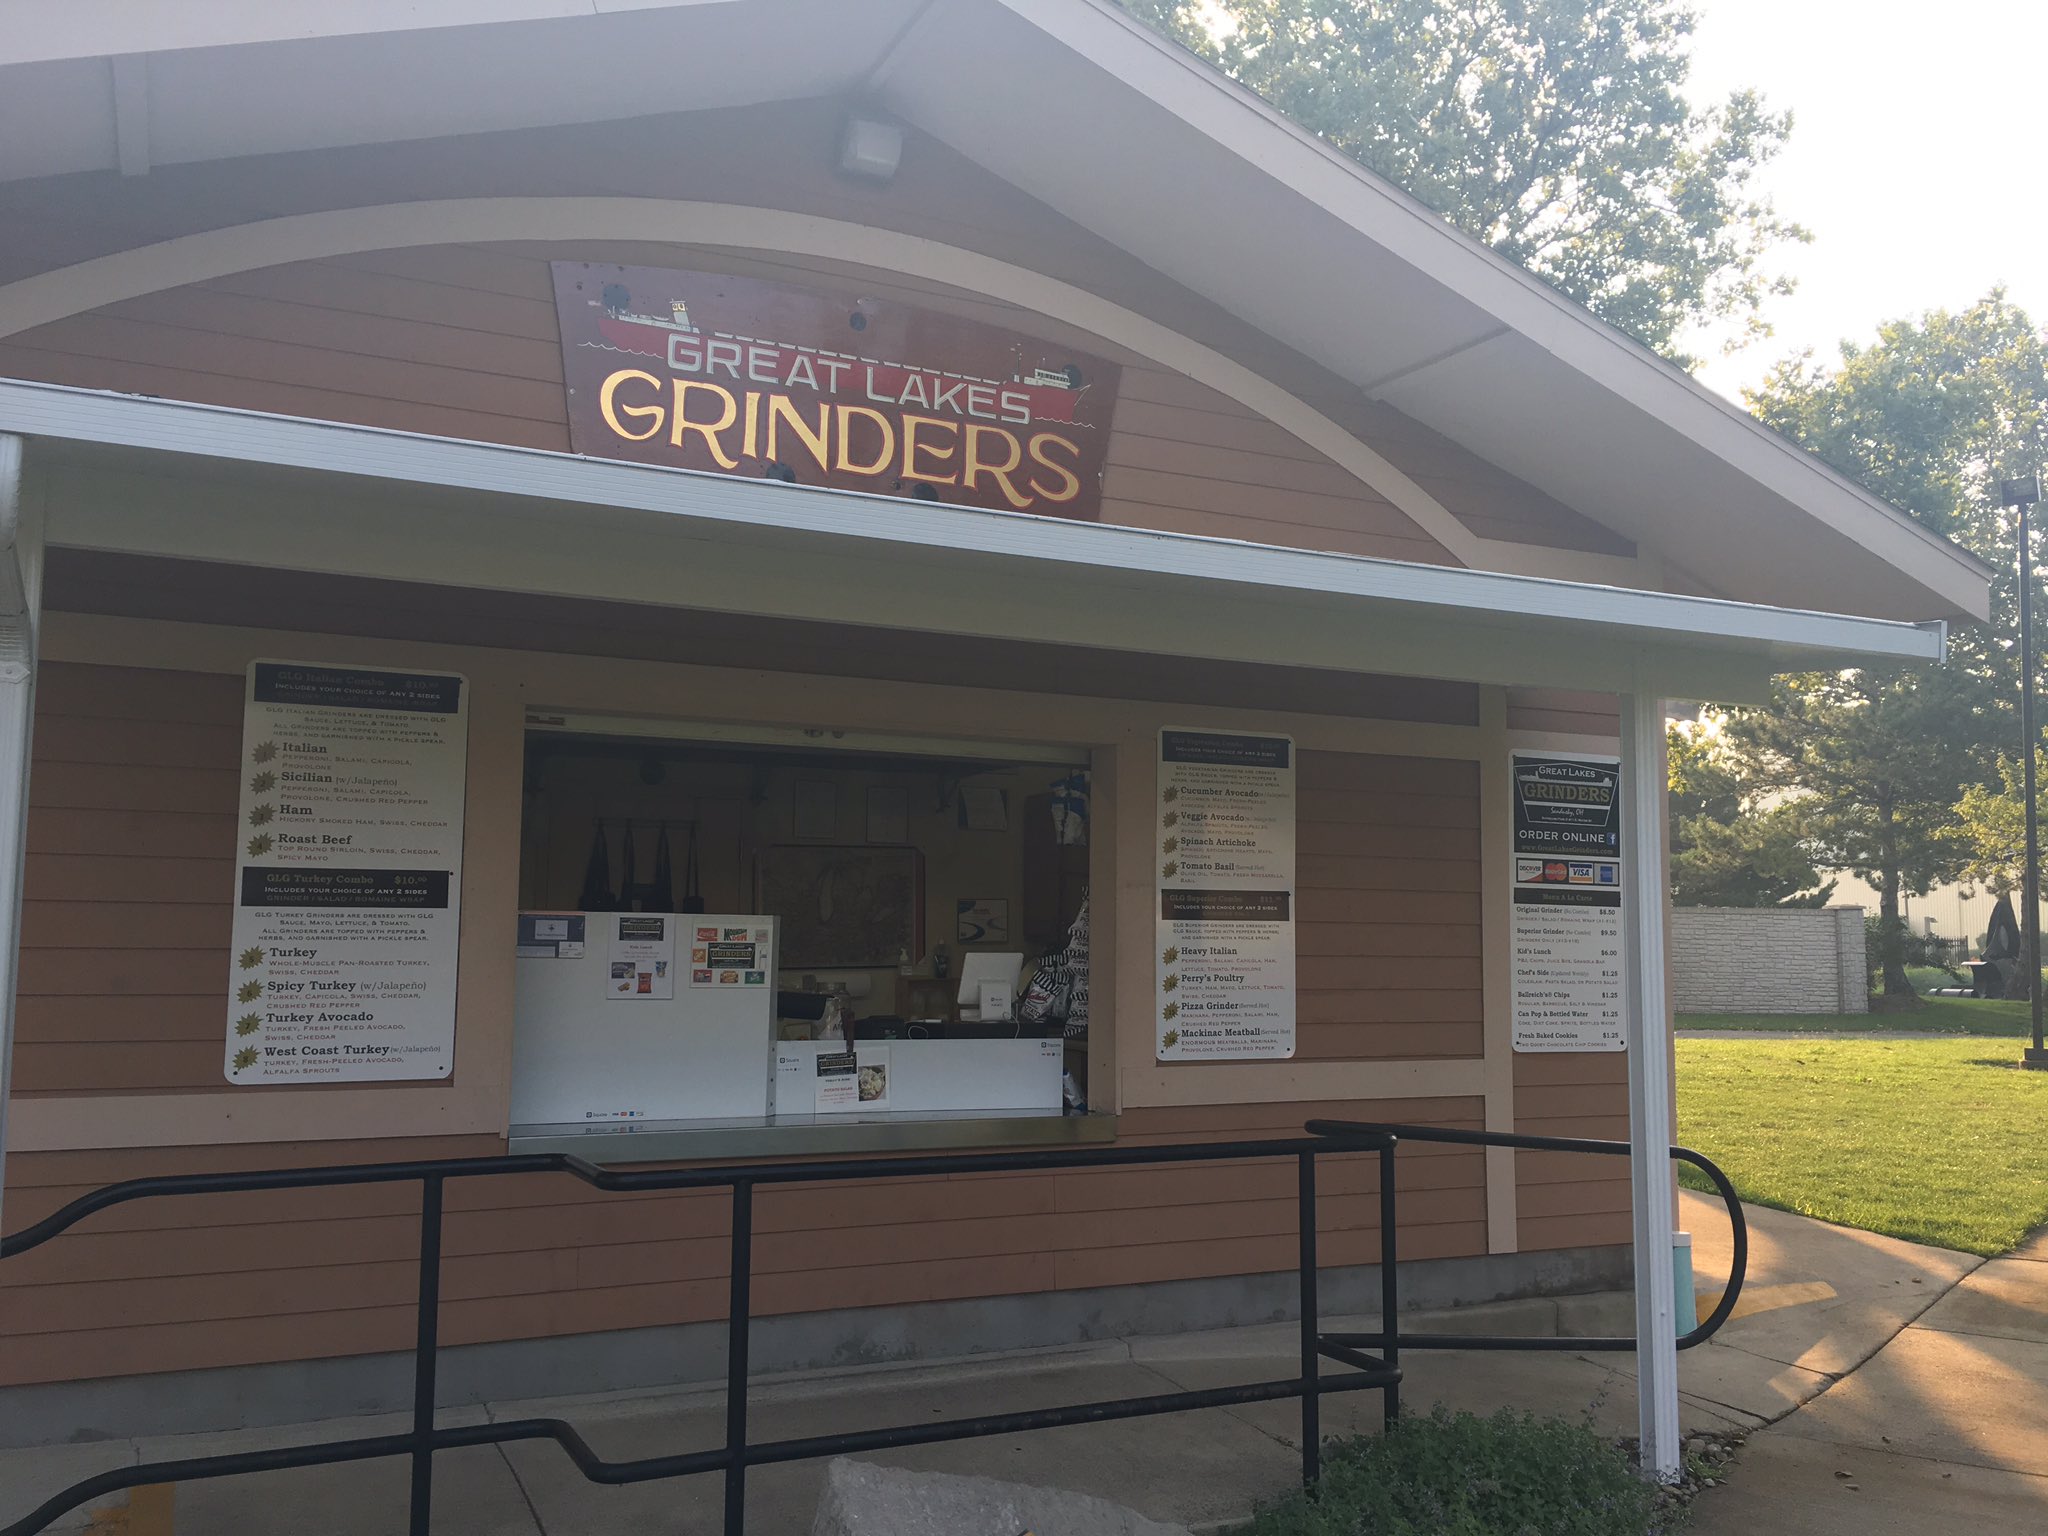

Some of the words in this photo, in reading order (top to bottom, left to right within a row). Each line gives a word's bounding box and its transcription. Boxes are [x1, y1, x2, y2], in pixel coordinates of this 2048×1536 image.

[667, 332, 852, 395] GREAT
[865, 366, 1032, 424] LAKES
[599, 369, 1082, 509] GRINDERS
[282, 742, 327, 754] Italian
[281, 771, 332, 784] Sicilian
[1538, 766, 1566, 776] GREAT
[1568, 768, 1596, 778] LAKES
[1180, 786, 1222, 796] Cucumber
[1224, 788, 1259, 798] Avocado
[1524, 784, 1610, 802] GRINDERS
[279, 804, 312, 816] Ham
[1180, 811, 1207, 822] Veggie
[1210, 812, 1245, 823] Avocado
[278, 833, 316, 844] Roast
[321, 834, 353, 845] Beef
[1180, 836, 1213, 847] Spinach
[1216, 837, 1256, 848] Artichoke
[1519, 830, 1558, 840] ORDER
[1562, 832, 1605, 842] ONLINE
[1180, 862, 1212, 871] Tomato
[1214, 862, 1235, 871] Basil
[1572, 868, 1589, 877] VISA
[266, 873, 290, 884] GLG
[293, 874, 332, 884] Turkey
[335, 874, 373, 885] Combo
[269, 947, 317, 958] Turkey
[1181, 946, 1207, 956] Heavy
[1209, 946, 1238, 956] Italian
[1181, 974, 1211, 984] Perry's
[1213, 974, 1245, 984] Poultry
[267, 981, 304, 992] Spicy
[309, 981, 356, 992] Turkey
[1181, 1002, 1203, 1010] Pizza
[1206, 1002, 1239, 1010] Grinder
[265, 1012, 313, 1023] Turkey
[317, 1011, 374, 1023] Avocado
[1181, 1028, 1222, 1038] Mackinac
[1224, 1028, 1260, 1037] Meatball
[264, 1046, 296, 1057] West
[301, 1046, 338, 1056] Coast
[343, 1045, 390, 1056] Turkey
